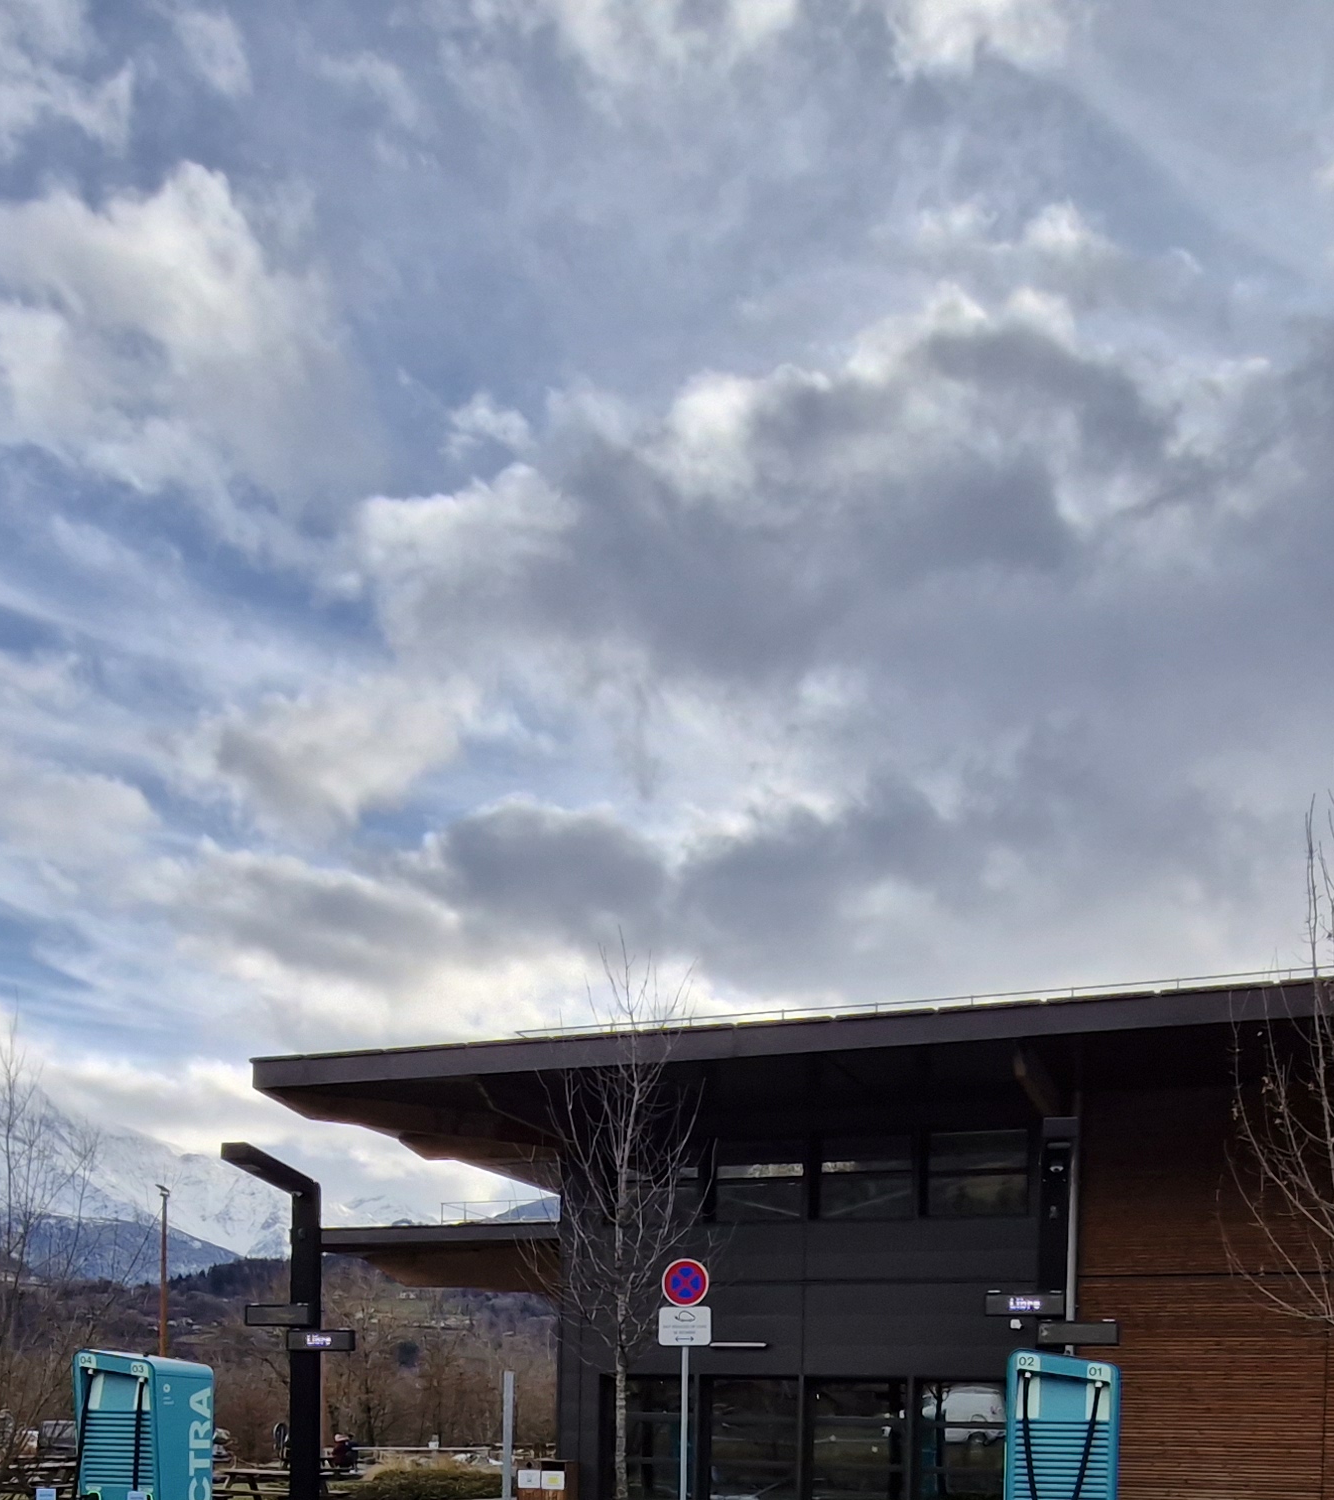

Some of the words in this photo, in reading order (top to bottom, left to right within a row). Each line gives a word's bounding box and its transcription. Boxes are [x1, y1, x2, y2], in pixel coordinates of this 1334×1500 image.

[1009, 1297, 1041, 1310] Libre
[80, 1356, 92, 1365] 04
[1019, 1356, 1034, 1367] 02
[132, 1365, 144, 1374] 03
[1089, 1367, 1102, 1377] 01
